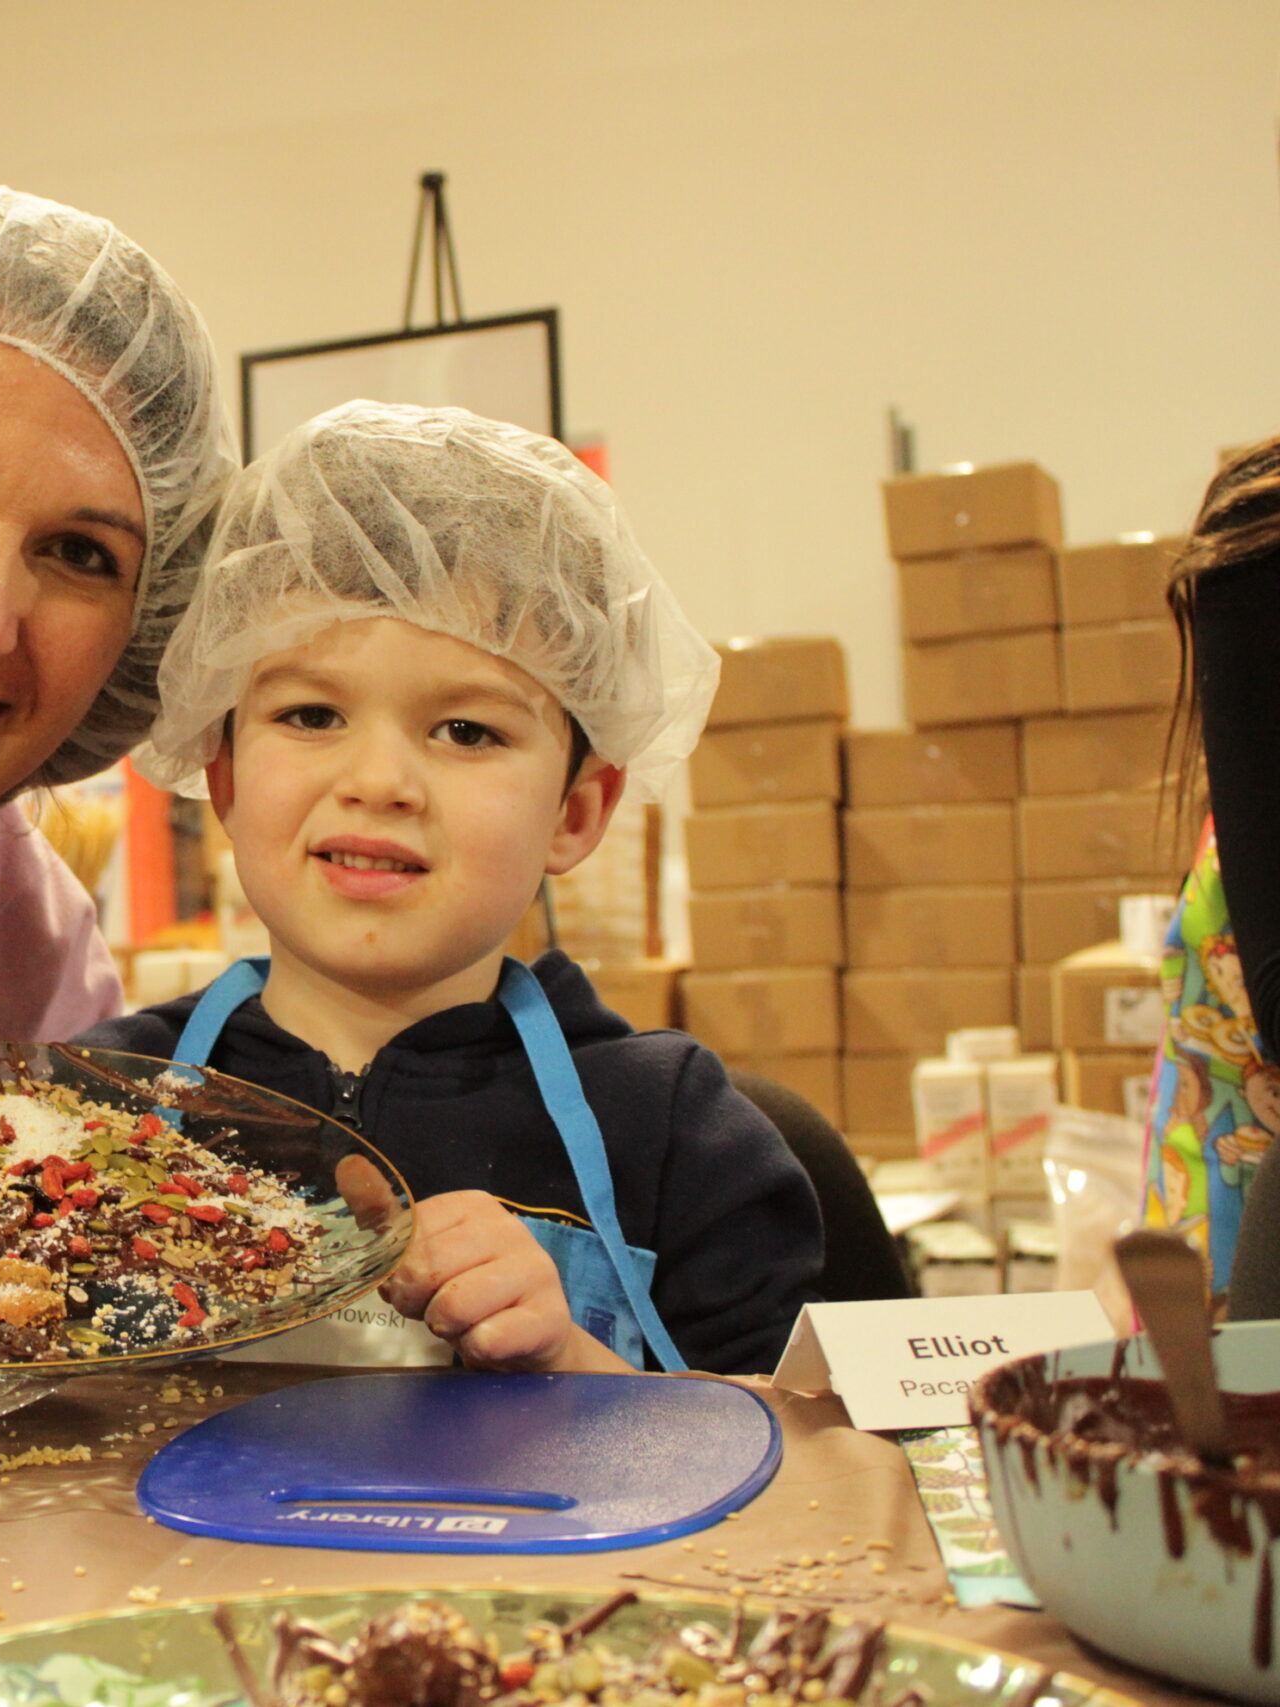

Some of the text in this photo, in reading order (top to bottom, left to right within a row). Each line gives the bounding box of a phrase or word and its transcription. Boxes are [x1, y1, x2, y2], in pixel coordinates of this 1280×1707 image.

[907, 1335, 1010, 1359] Elliot
[899, 1380, 978, 1397] Paca
[284, 1509, 436, 1529] Library
